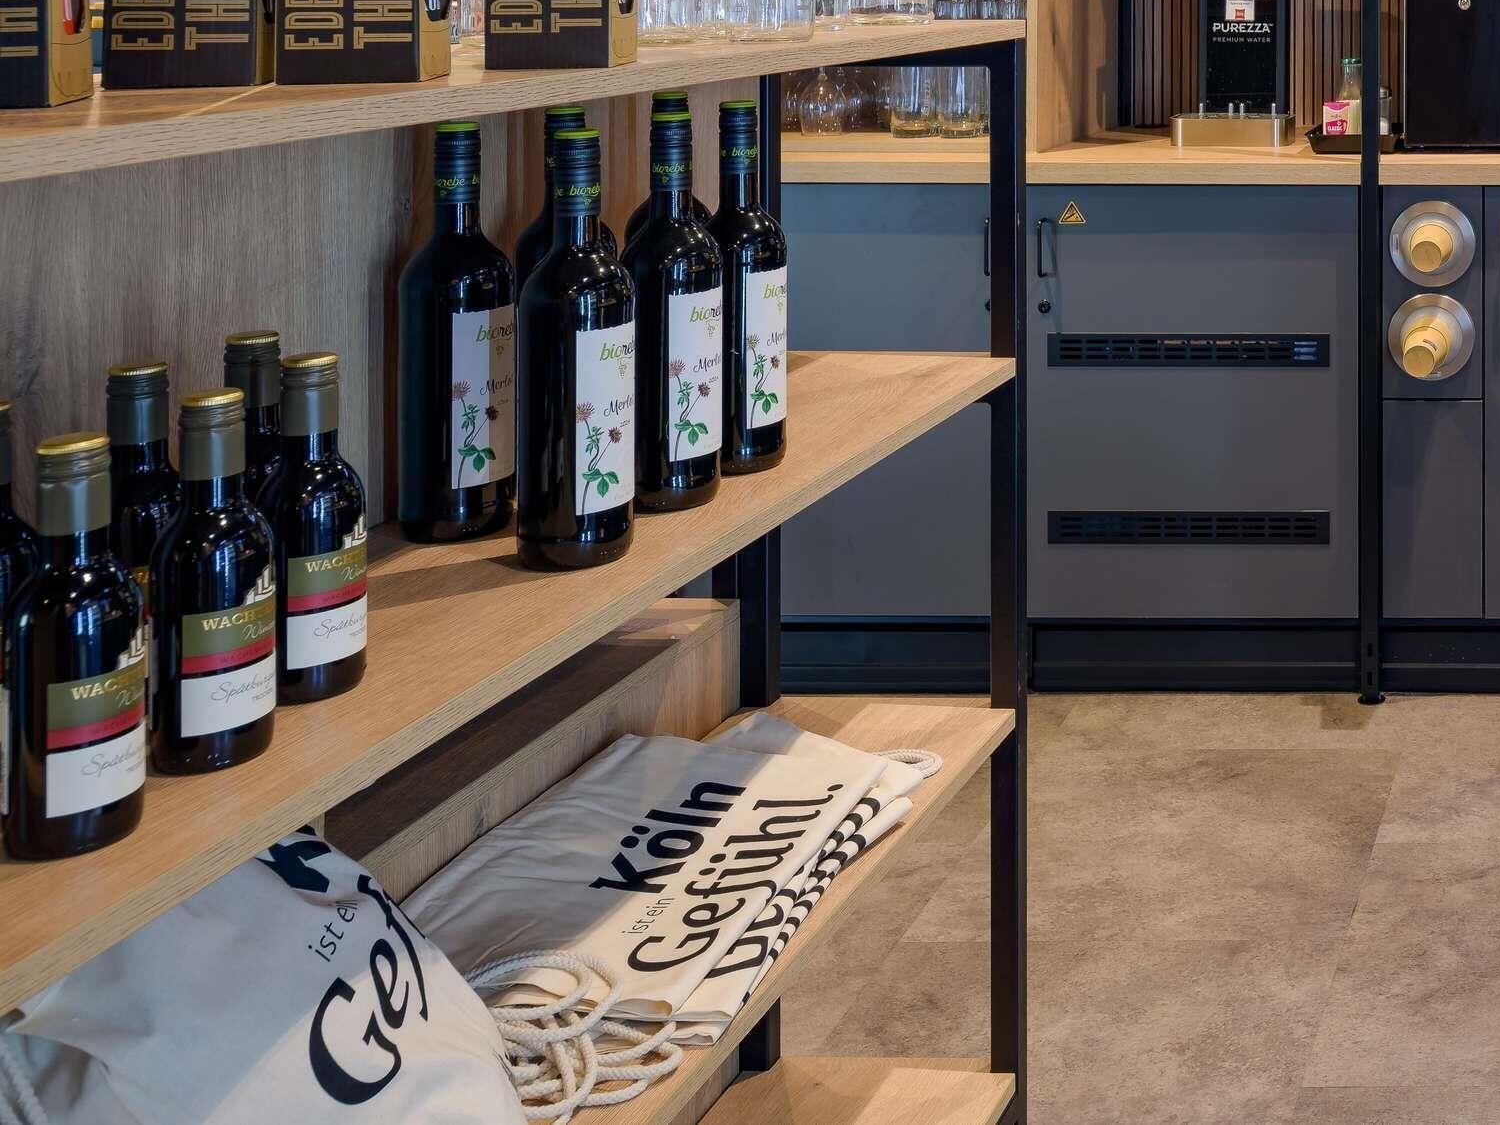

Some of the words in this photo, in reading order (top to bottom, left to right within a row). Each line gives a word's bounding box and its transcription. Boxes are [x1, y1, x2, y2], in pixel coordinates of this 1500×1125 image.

[1213, 23, 1271, 33] PUREZZA
[589, 782, 747, 893] Köln
[628, 783, 844, 972] Gefühl.
[308, 922, 344, 962] ist
[621, 916, 657, 935] ist
[645, 896, 675, 918] ein
[309, 874, 428, 1105] Gef
